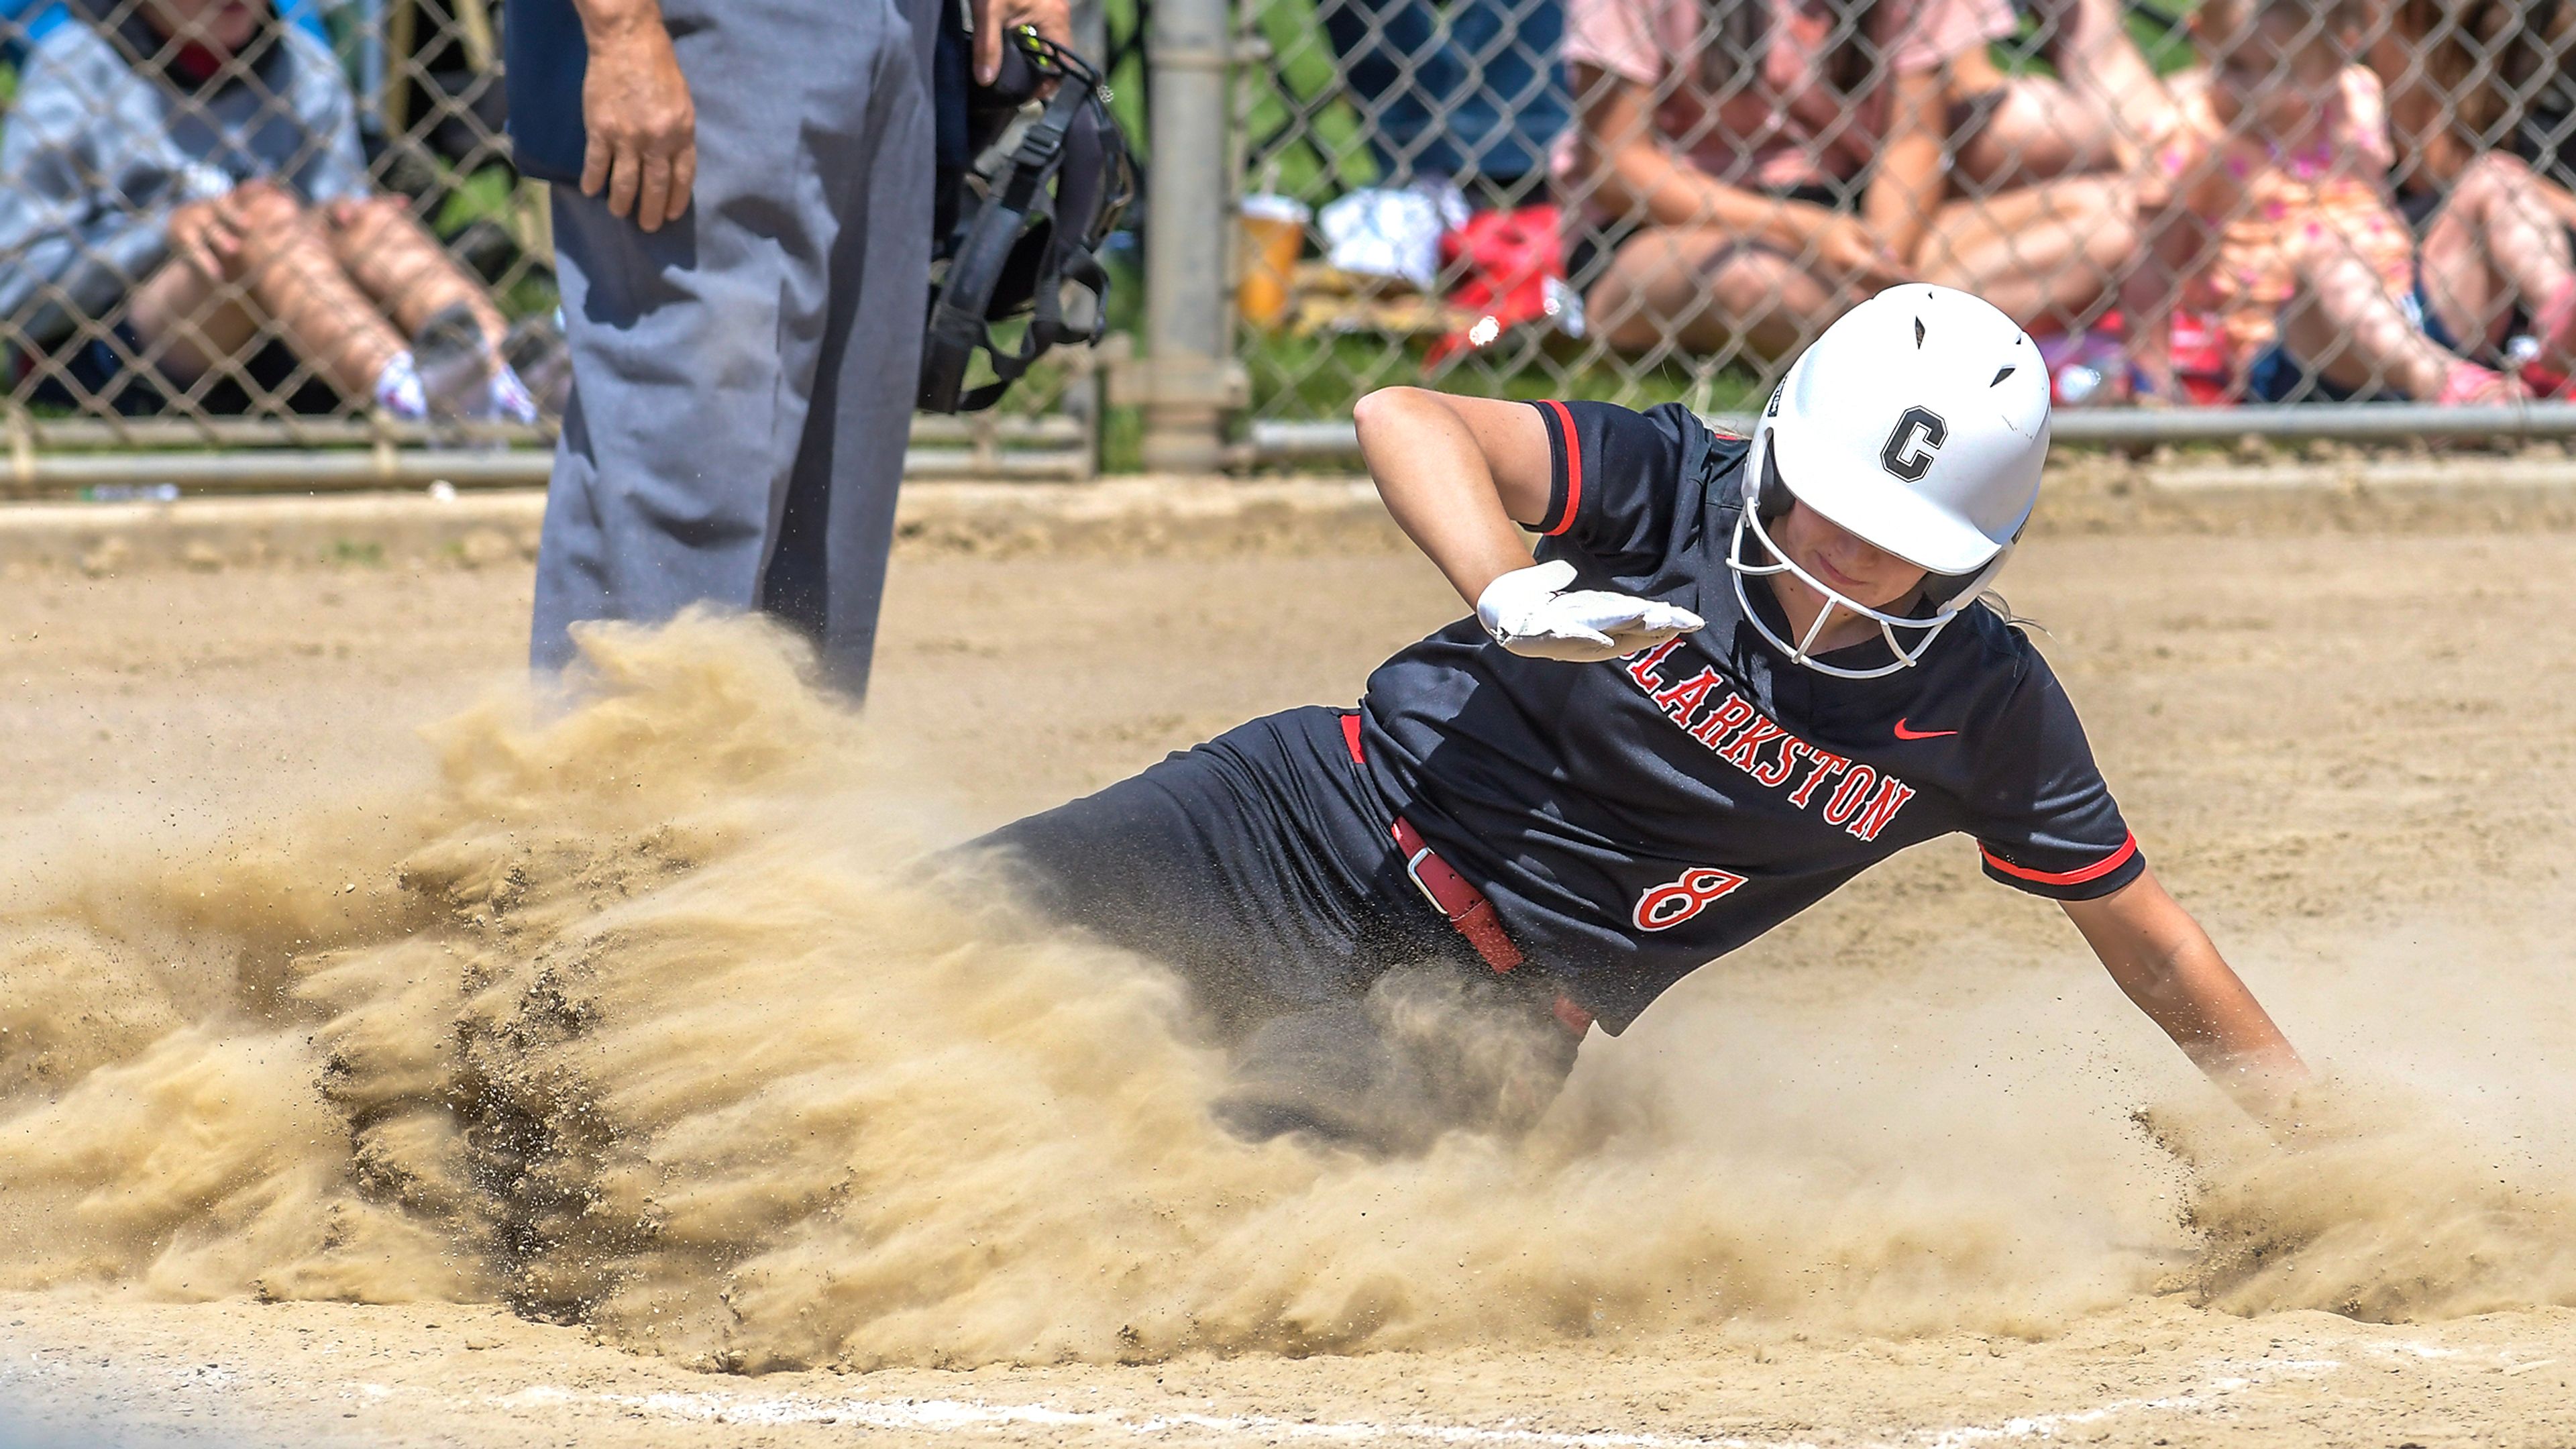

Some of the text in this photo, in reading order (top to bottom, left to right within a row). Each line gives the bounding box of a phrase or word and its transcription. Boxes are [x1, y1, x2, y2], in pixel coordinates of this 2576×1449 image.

[1880, 405, 1948, 483] C
[1619, 637, 1917, 843] LARKSTON
[1632, 867, 1750, 932] 8
